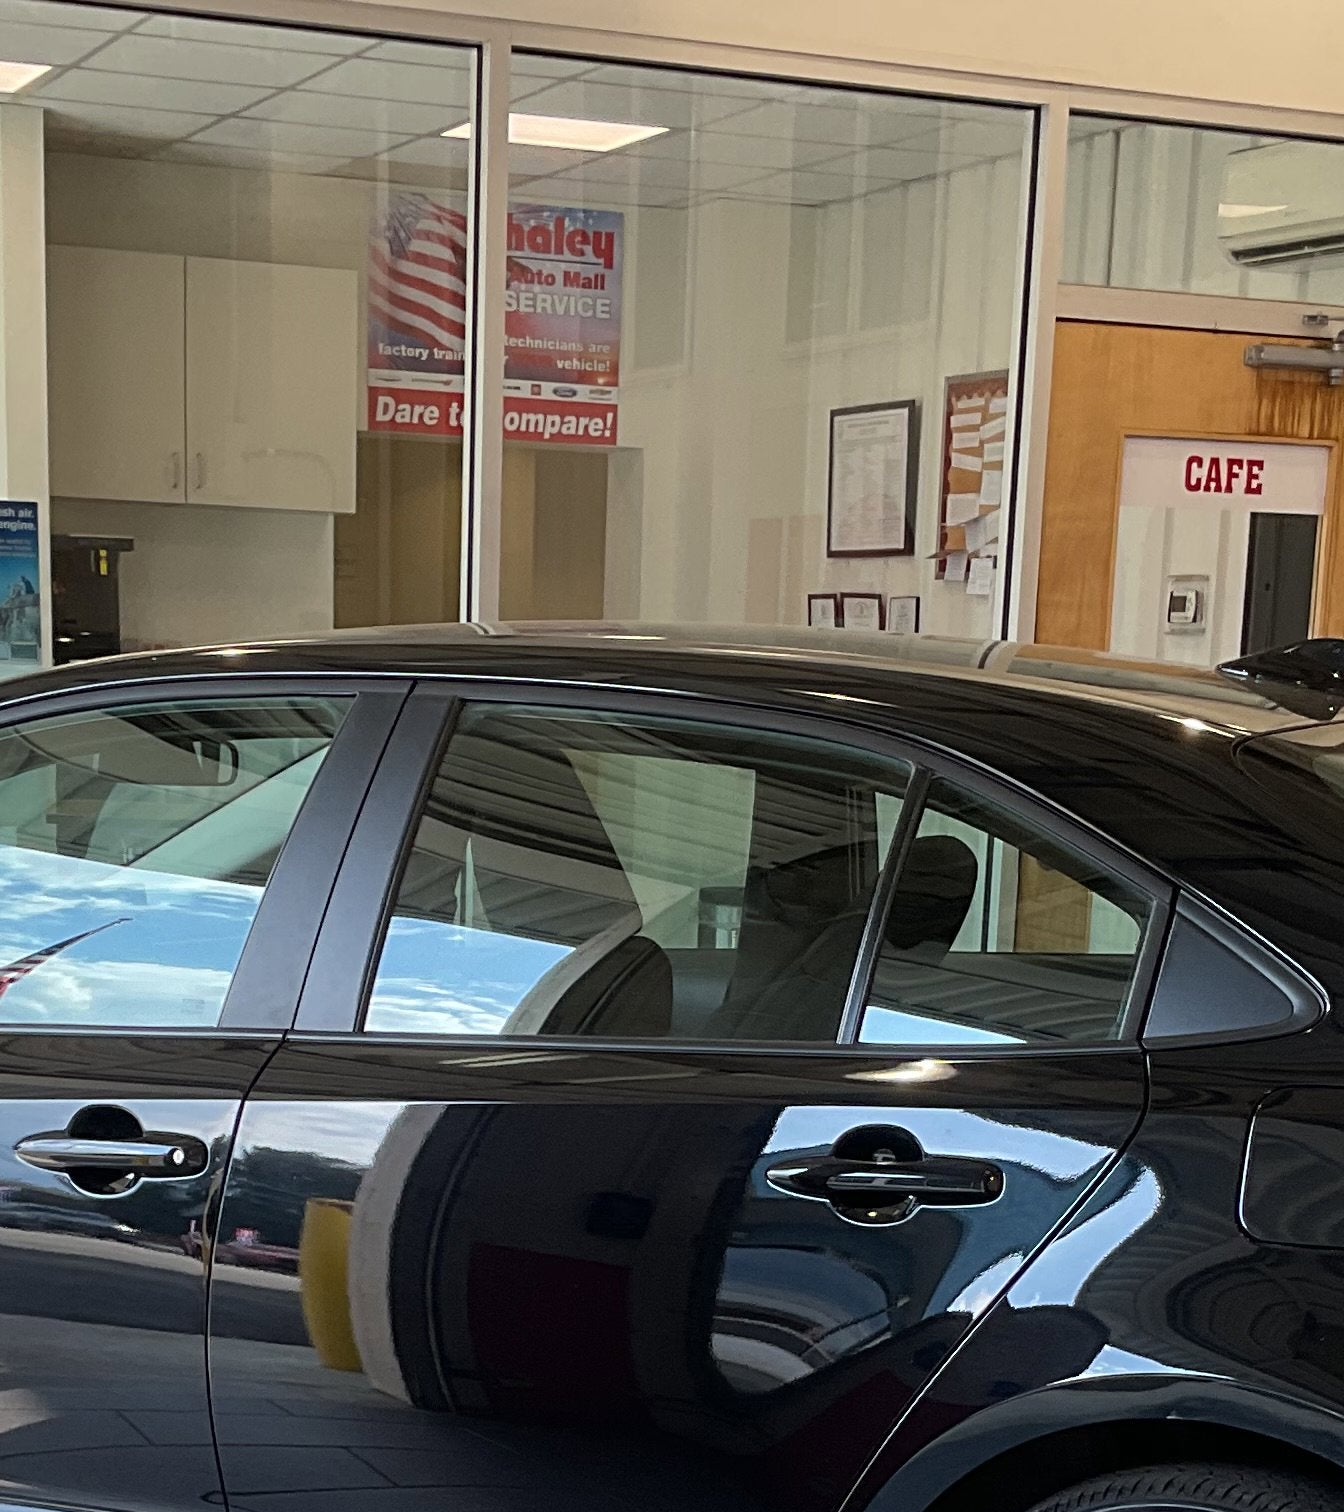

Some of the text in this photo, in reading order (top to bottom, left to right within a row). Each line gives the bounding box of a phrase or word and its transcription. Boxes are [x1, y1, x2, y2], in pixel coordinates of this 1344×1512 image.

[507, 213, 615, 270] haley
[563, 270, 606, 290] Mall
[505, 290, 612, 319] SERVICE
[378, 342, 429, 361] factory
[588, 343, 611, 354] are
[556, 358, 611, 372] vehicle!
[376, 396, 440, 426] Dare
[504, 411, 614, 440] ompare!
[1185, 456, 1265, 495] CAFE
